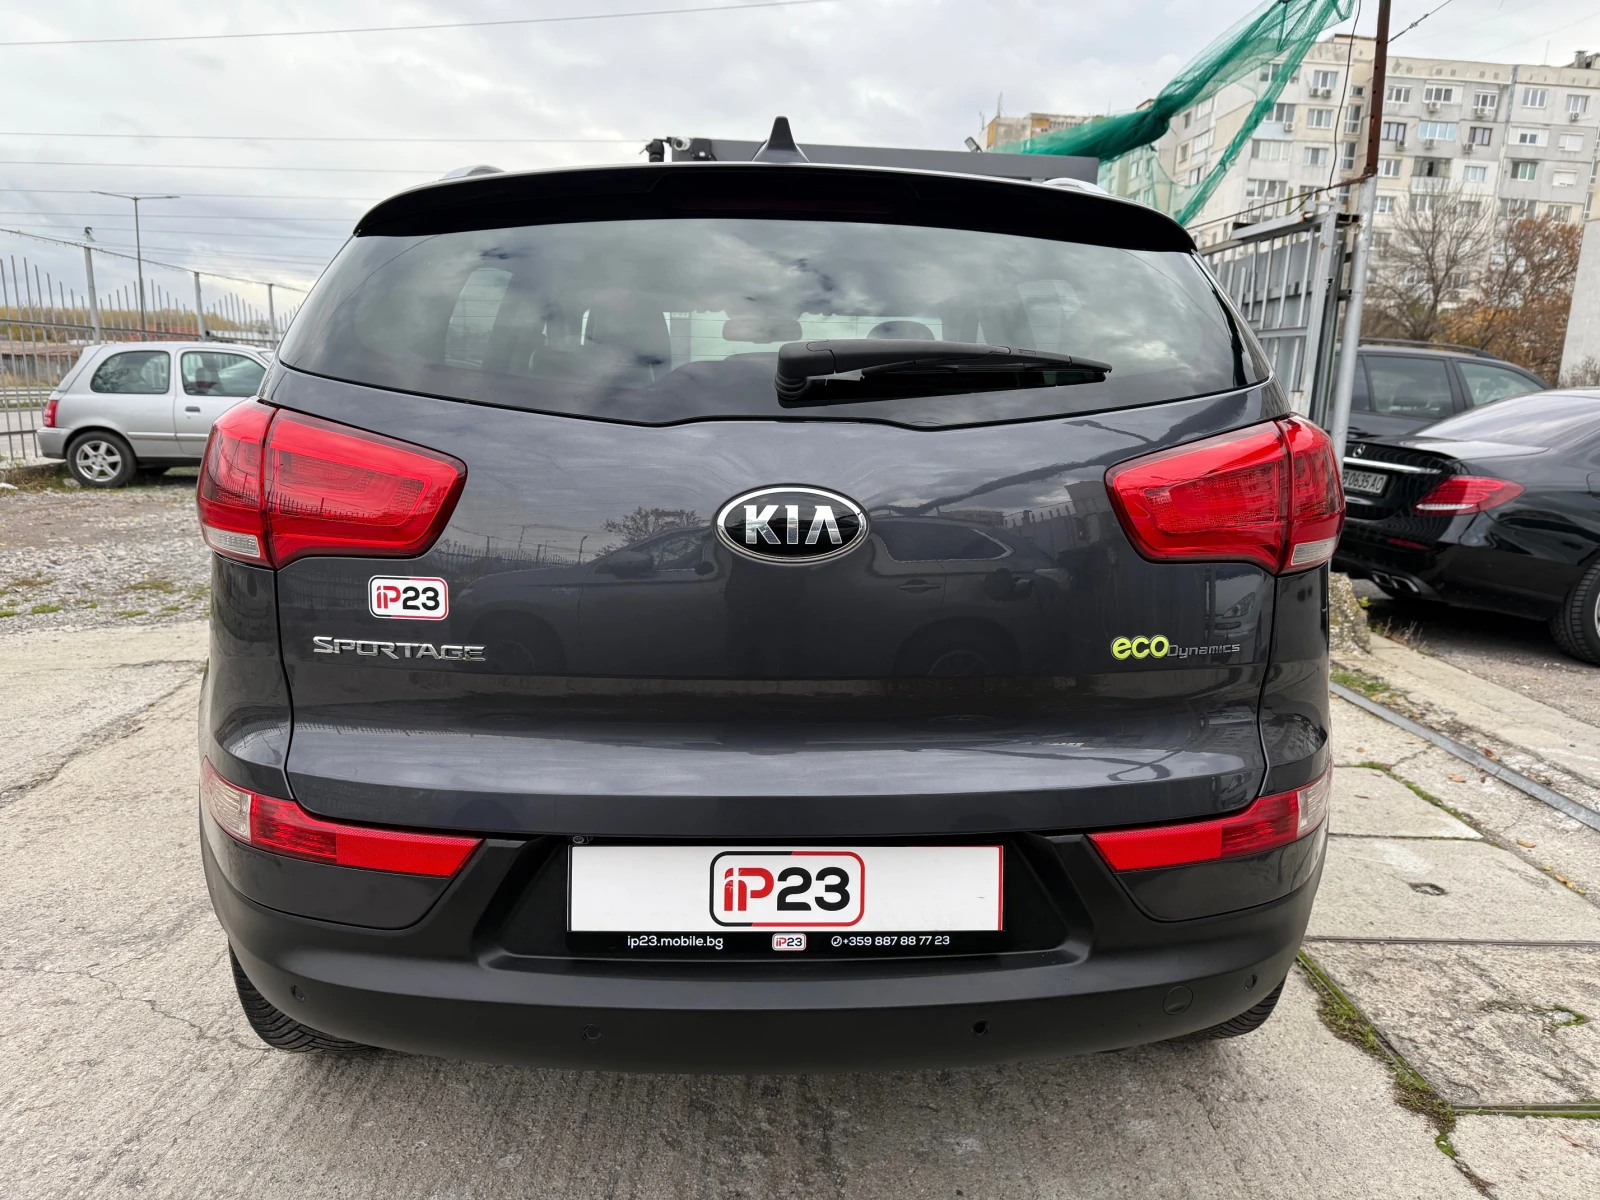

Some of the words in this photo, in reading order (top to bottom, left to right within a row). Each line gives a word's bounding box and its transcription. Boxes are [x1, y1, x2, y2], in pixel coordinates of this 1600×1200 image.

[743, 504, 843, 545] KIA
[312, 635, 487, 662] SPORTAGE
[627, 935, 724, 950] ip23.mobile.bg
[842, 936, 872, 946] +359
[874, 936, 898, 946] 887
[900, 935, 916, 946] 88
[918, 935, 933, 946] 77
[934, 935, 951, 945] 23
